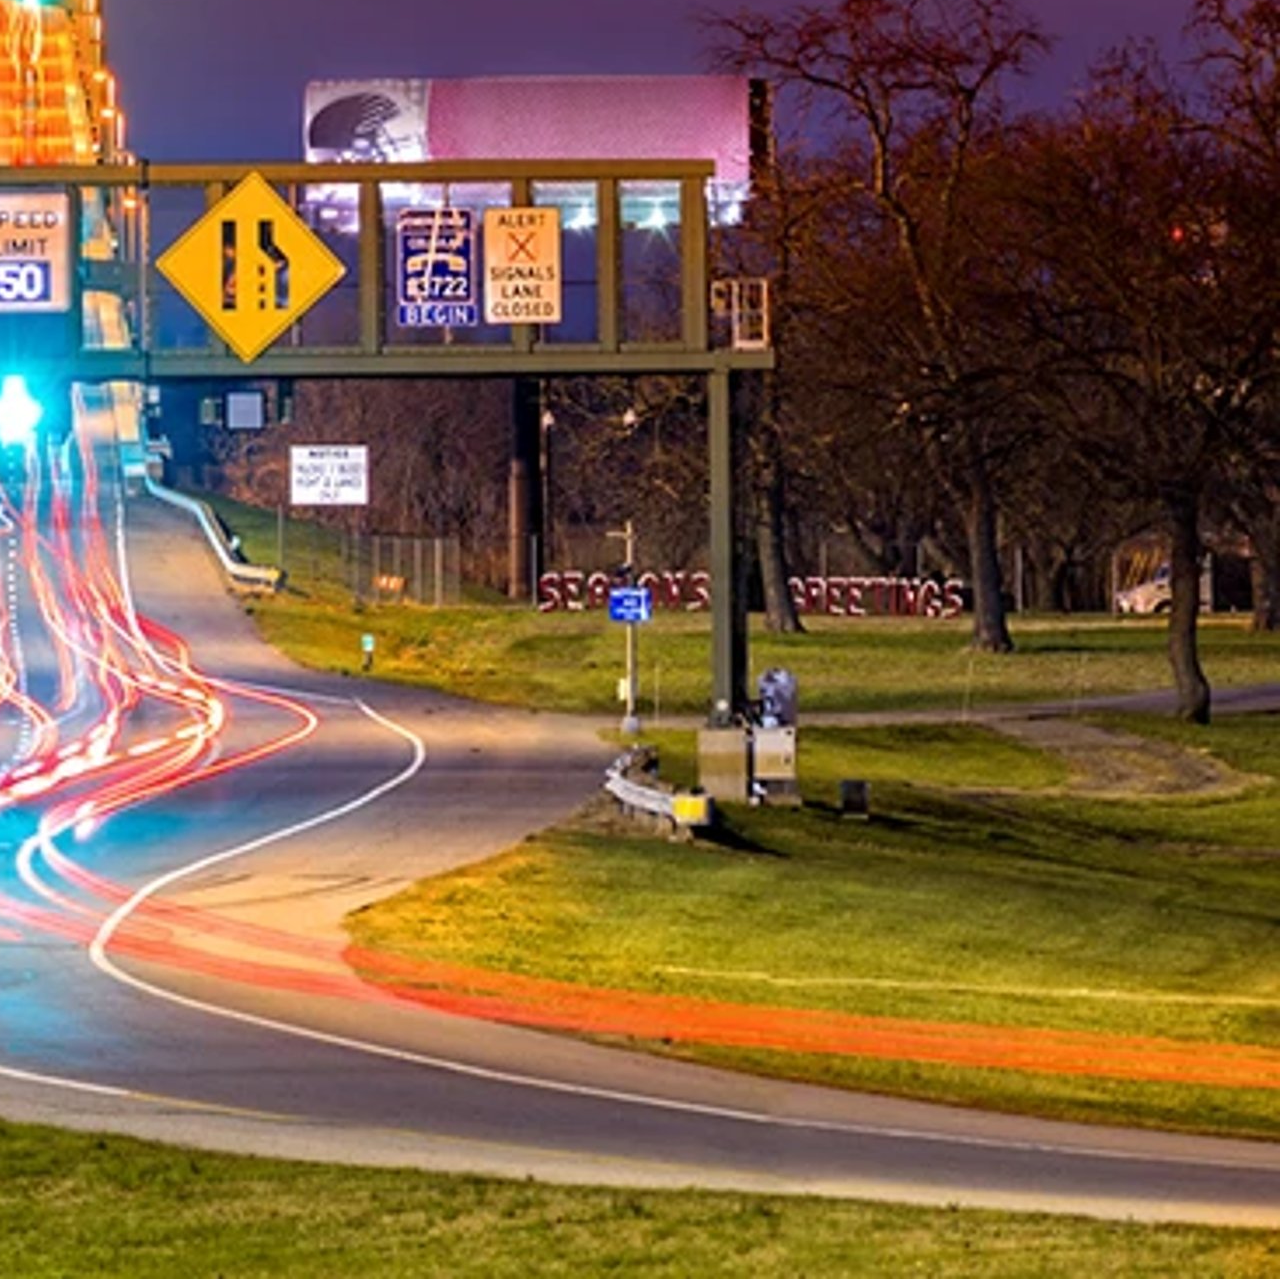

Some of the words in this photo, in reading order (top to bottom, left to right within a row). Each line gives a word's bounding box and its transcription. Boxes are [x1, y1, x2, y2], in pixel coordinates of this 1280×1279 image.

[498, 213, 545, 227] ALERT
[490, 266, 555, 281] SIGNALS
[500, 284, 543, 299] LANE
[405, 305, 469, 323] BEGIN
[491, 301, 555, 317] CLOSED
[538, 571, 711, 612] SEAONS
[787, 575, 965, 619] GREETINGS
